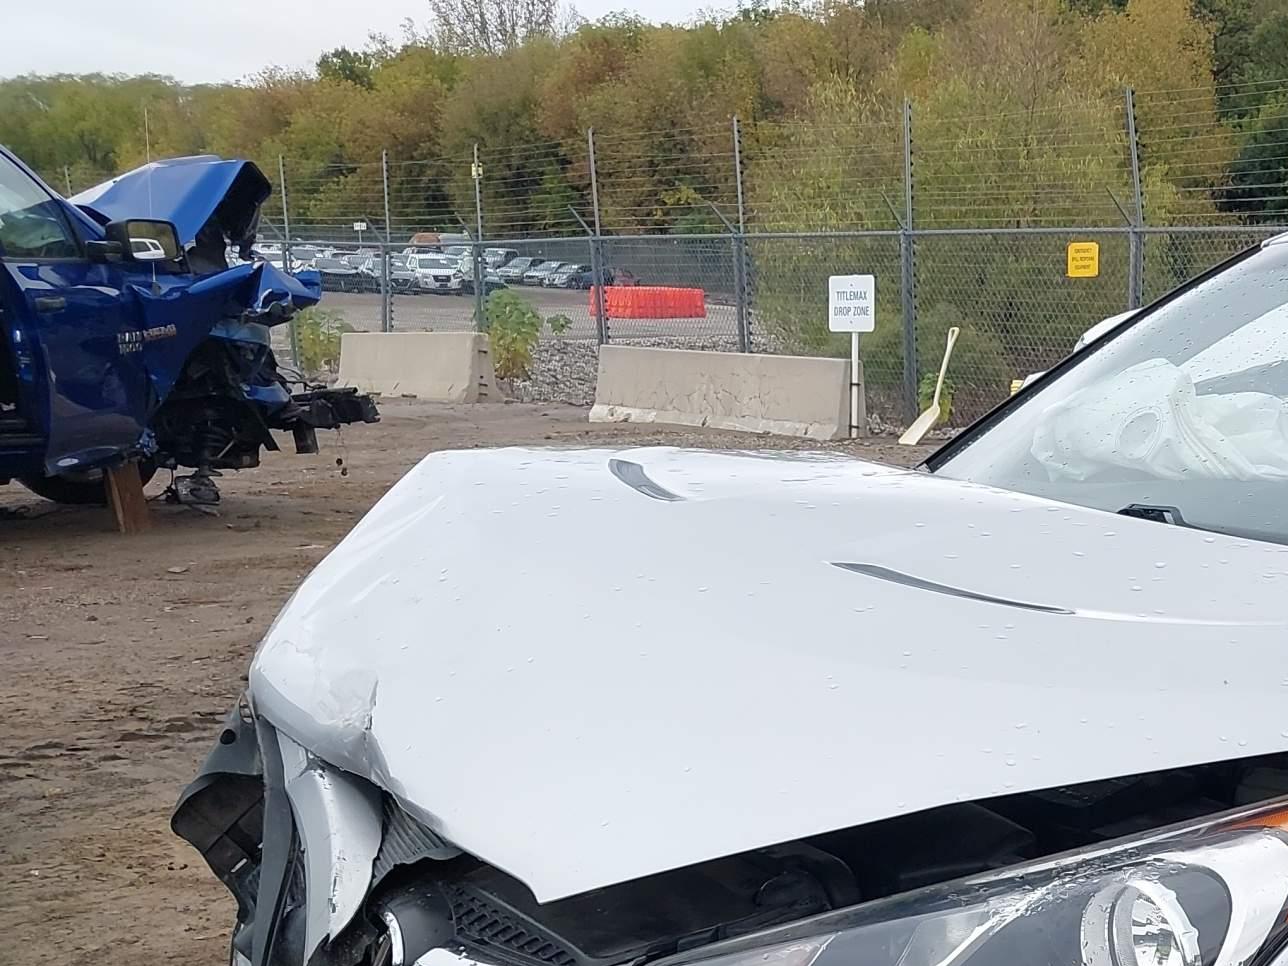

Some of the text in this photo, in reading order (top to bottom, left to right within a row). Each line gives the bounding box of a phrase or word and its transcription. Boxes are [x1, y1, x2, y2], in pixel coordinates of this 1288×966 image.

[836, 290, 868, 301] TITLEMAX
[834, 305, 870, 317] DROP ZONE
